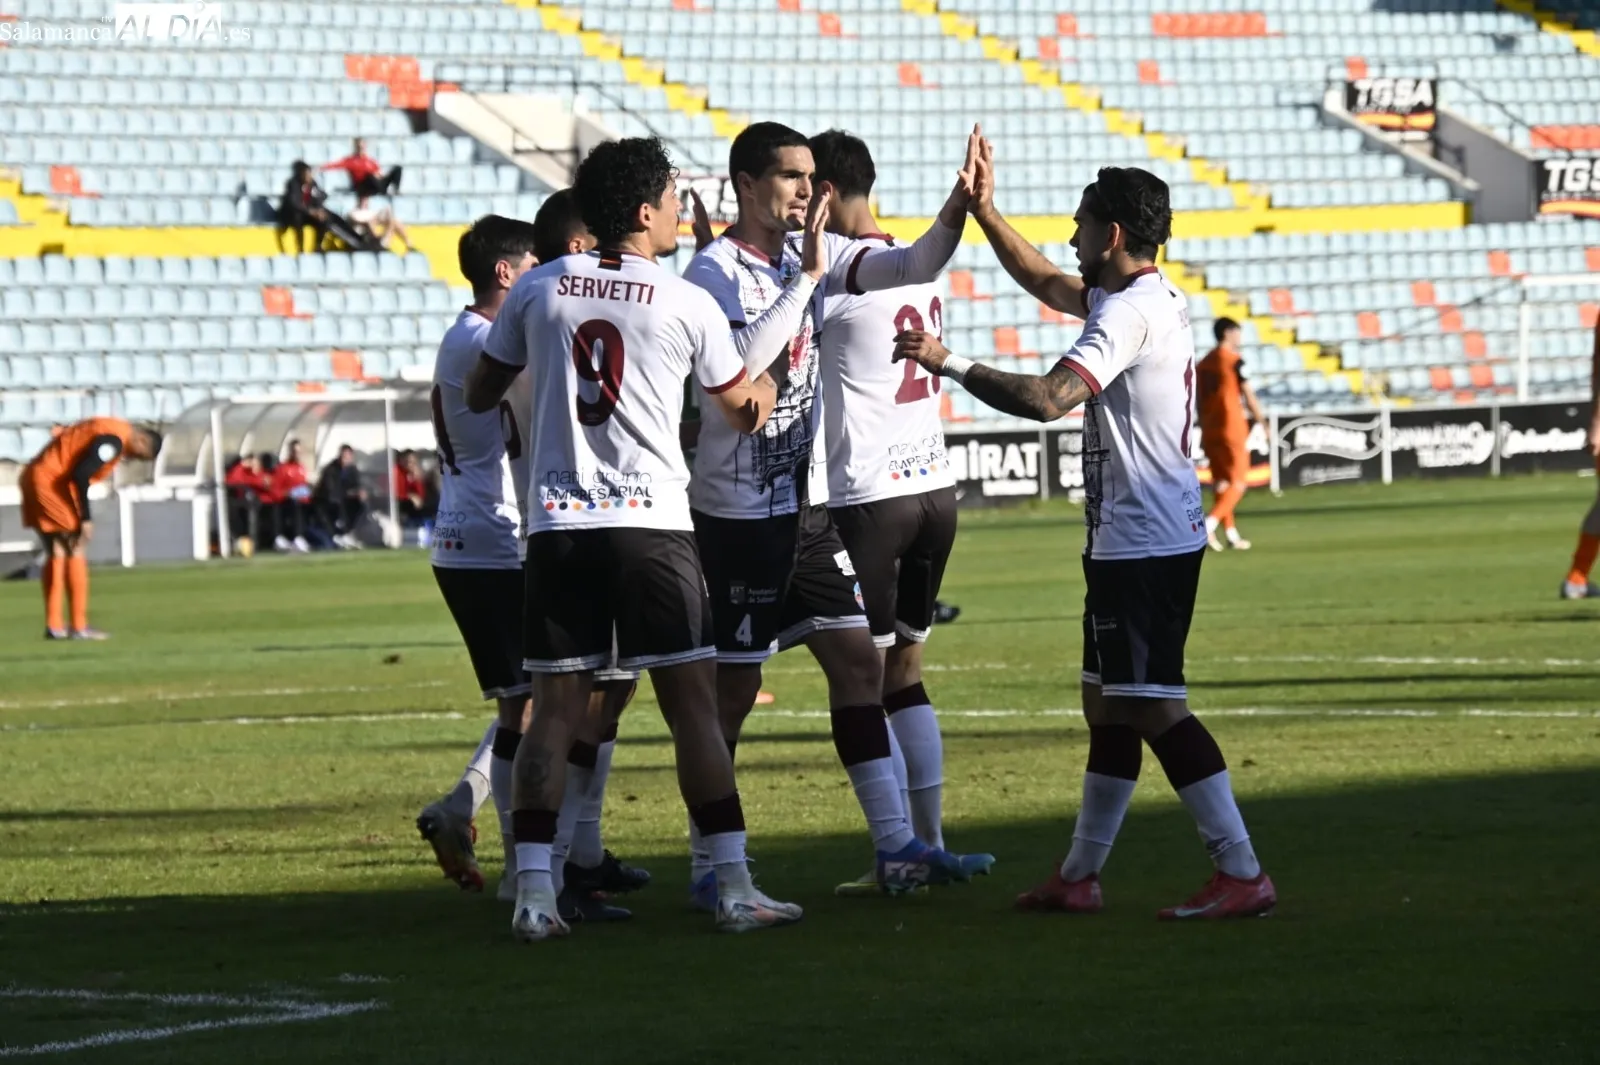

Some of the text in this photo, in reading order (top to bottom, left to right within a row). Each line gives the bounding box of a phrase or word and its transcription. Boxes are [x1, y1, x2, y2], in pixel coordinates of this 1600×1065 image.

[1353, 78, 1434, 106] TGSA
[557, 274, 655, 305] SERVETTI
[572, 318, 625, 427] 9
[547, 467, 585, 485] nani
[546, 486, 653, 501] EMPRESARIAL
[734, 612, 753, 647] 4
